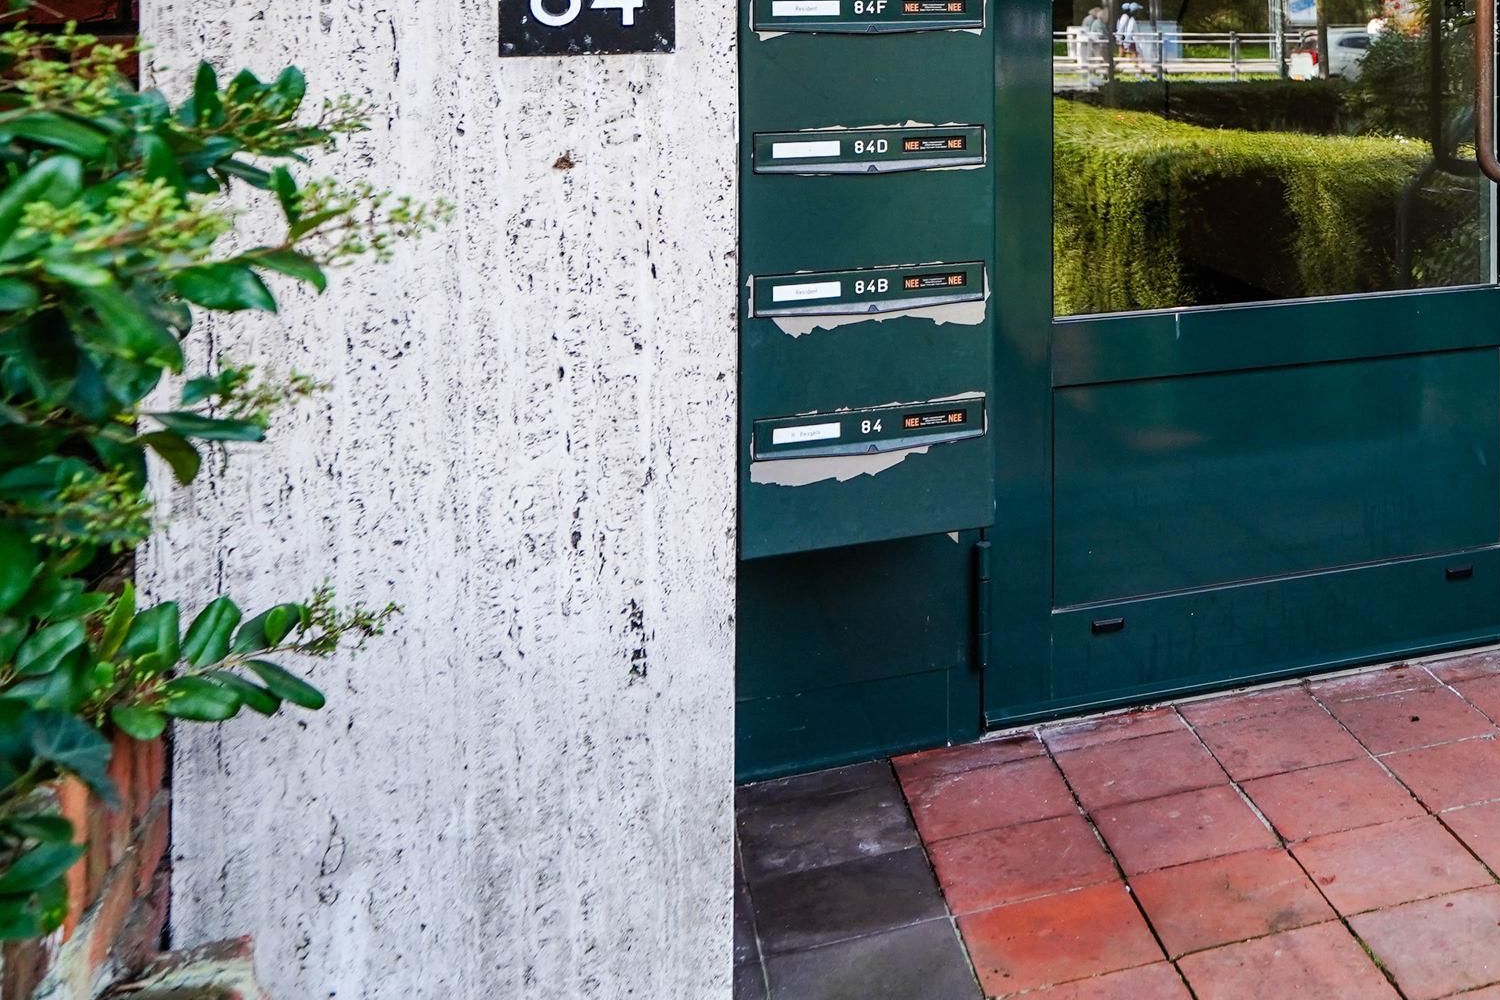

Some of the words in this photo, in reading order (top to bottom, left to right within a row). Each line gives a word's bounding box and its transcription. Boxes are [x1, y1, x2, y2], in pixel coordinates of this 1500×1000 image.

[854, 0, 887, 14] 84F
[904, 3, 919, 12] NEE
[947, 2, 962, 11] NEE
[854, 139, 888, 154] 84D
[904, 141, 919, 150] NEE
[947, 139, 962, 149] NEE
[854, 278, 889, 294] 84B
[905, 278, 920, 288] NEE
[948, 275, 962, 285] NEE
[861, 418, 883, 434] 84
[905, 418, 920, 427] NEE
[948, 413, 962, 423] NEE
